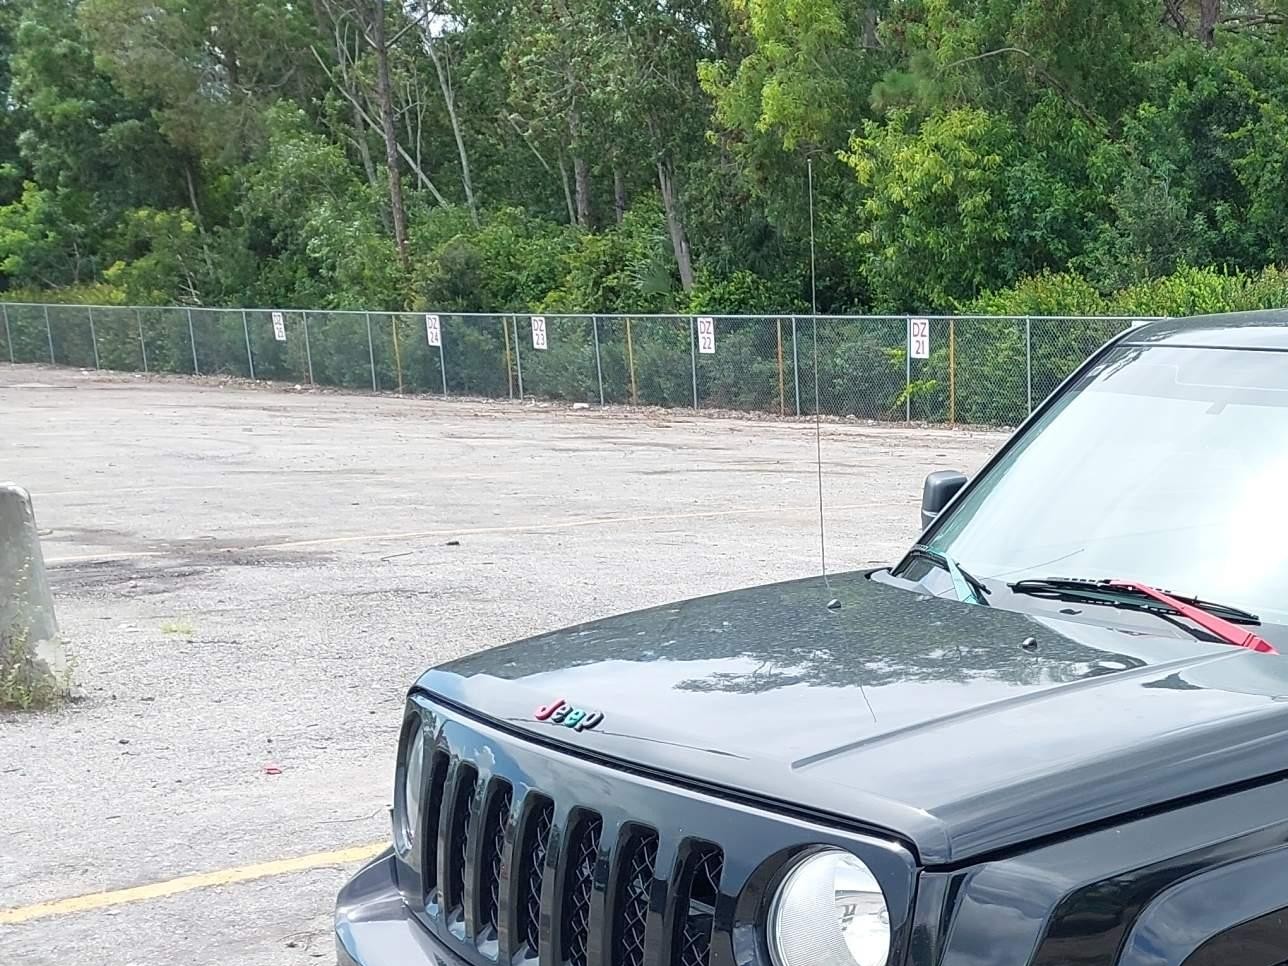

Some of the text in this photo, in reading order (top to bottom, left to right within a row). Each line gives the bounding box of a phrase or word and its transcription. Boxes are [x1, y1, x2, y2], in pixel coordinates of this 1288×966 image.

[427, 316, 438, 330] DZ
[533, 319, 544, 331] DZ
[699, 320, 712, 334] DZ
[912, 322, 928, 338] DZ
[430, 331, 439, 344] 24
[535, 333, 545, 346] 23
[701, 336, 712, 349] 22
[915, 339, 925, 354] 21
[535, 698, 604, 732] Jeep
